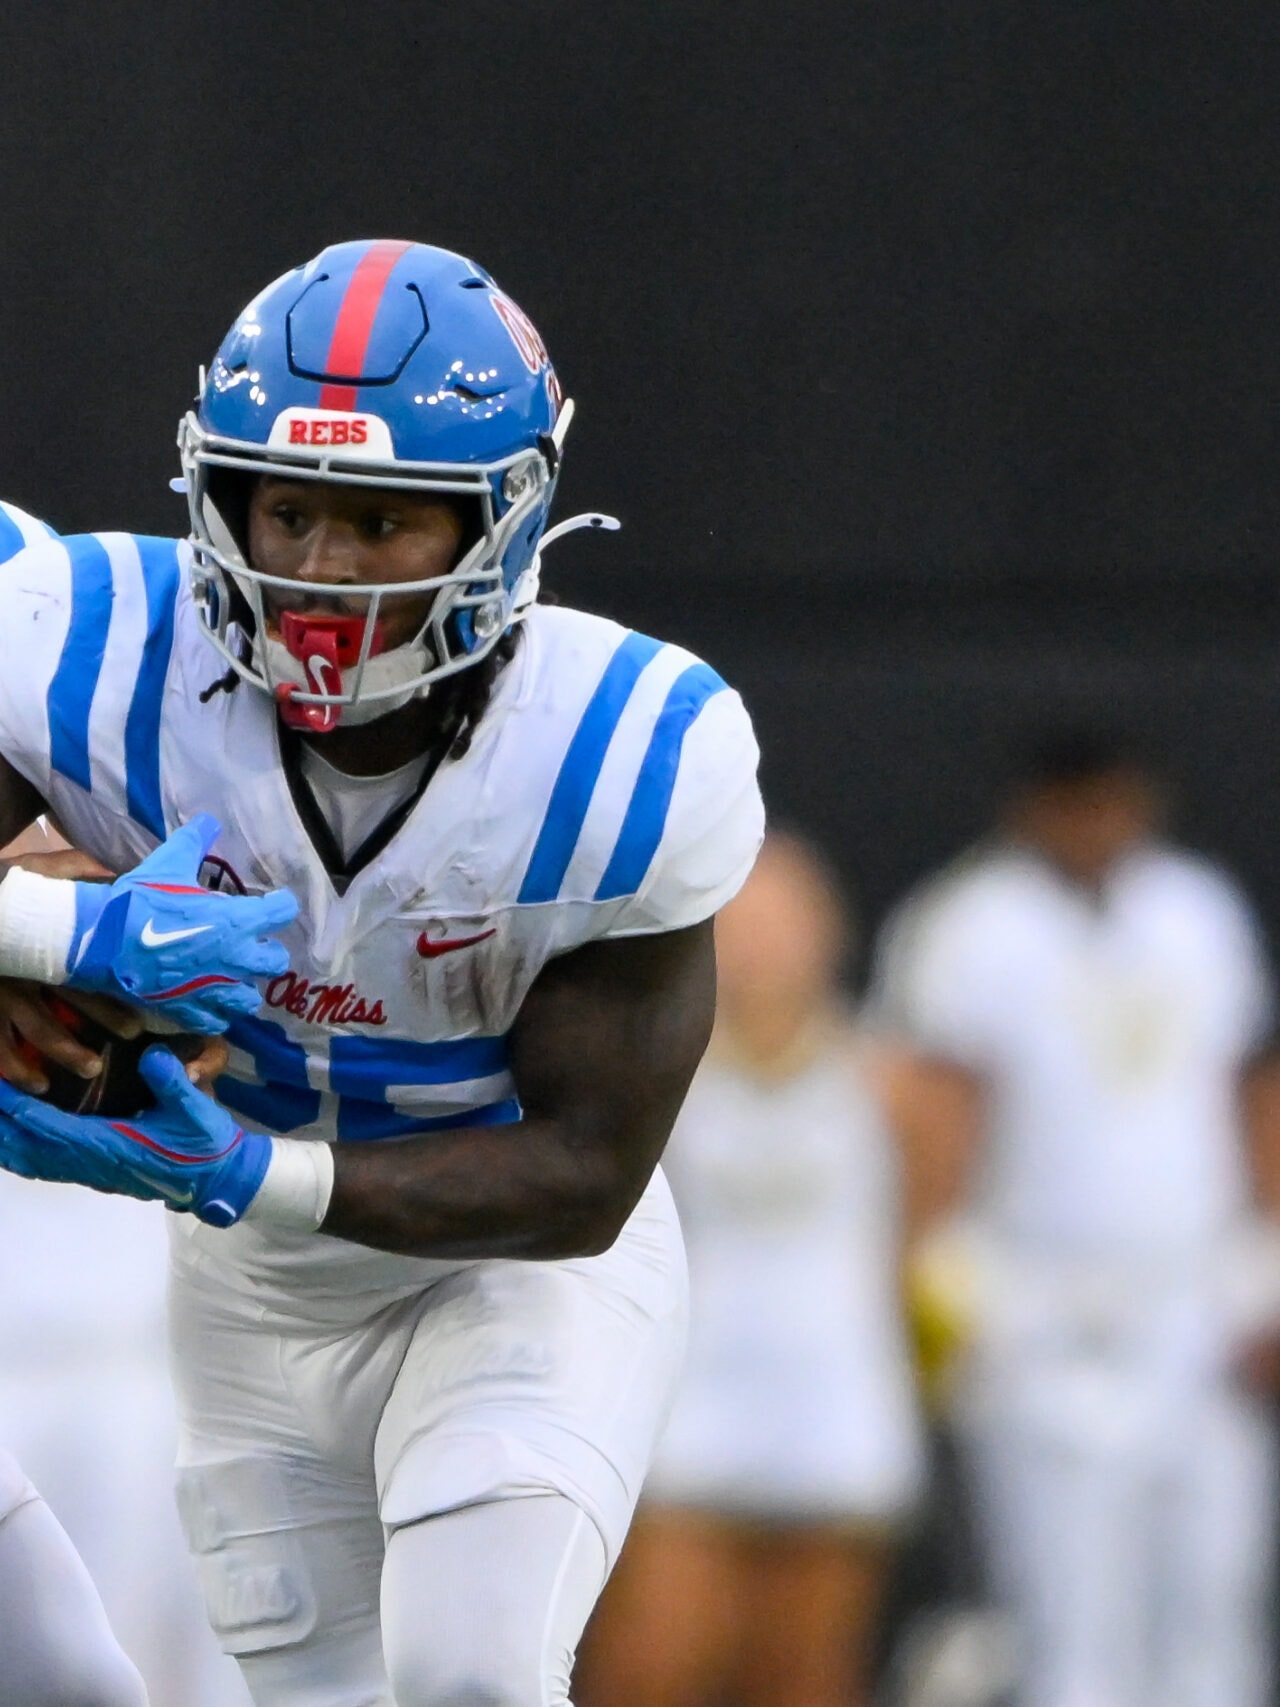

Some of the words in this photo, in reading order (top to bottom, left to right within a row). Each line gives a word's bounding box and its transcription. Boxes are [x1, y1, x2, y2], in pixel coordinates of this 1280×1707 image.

[288, 420, 368, 445] REBS
[265, 971, 309, 1019] Ole
[306, 983, 388, 1025] Miss
